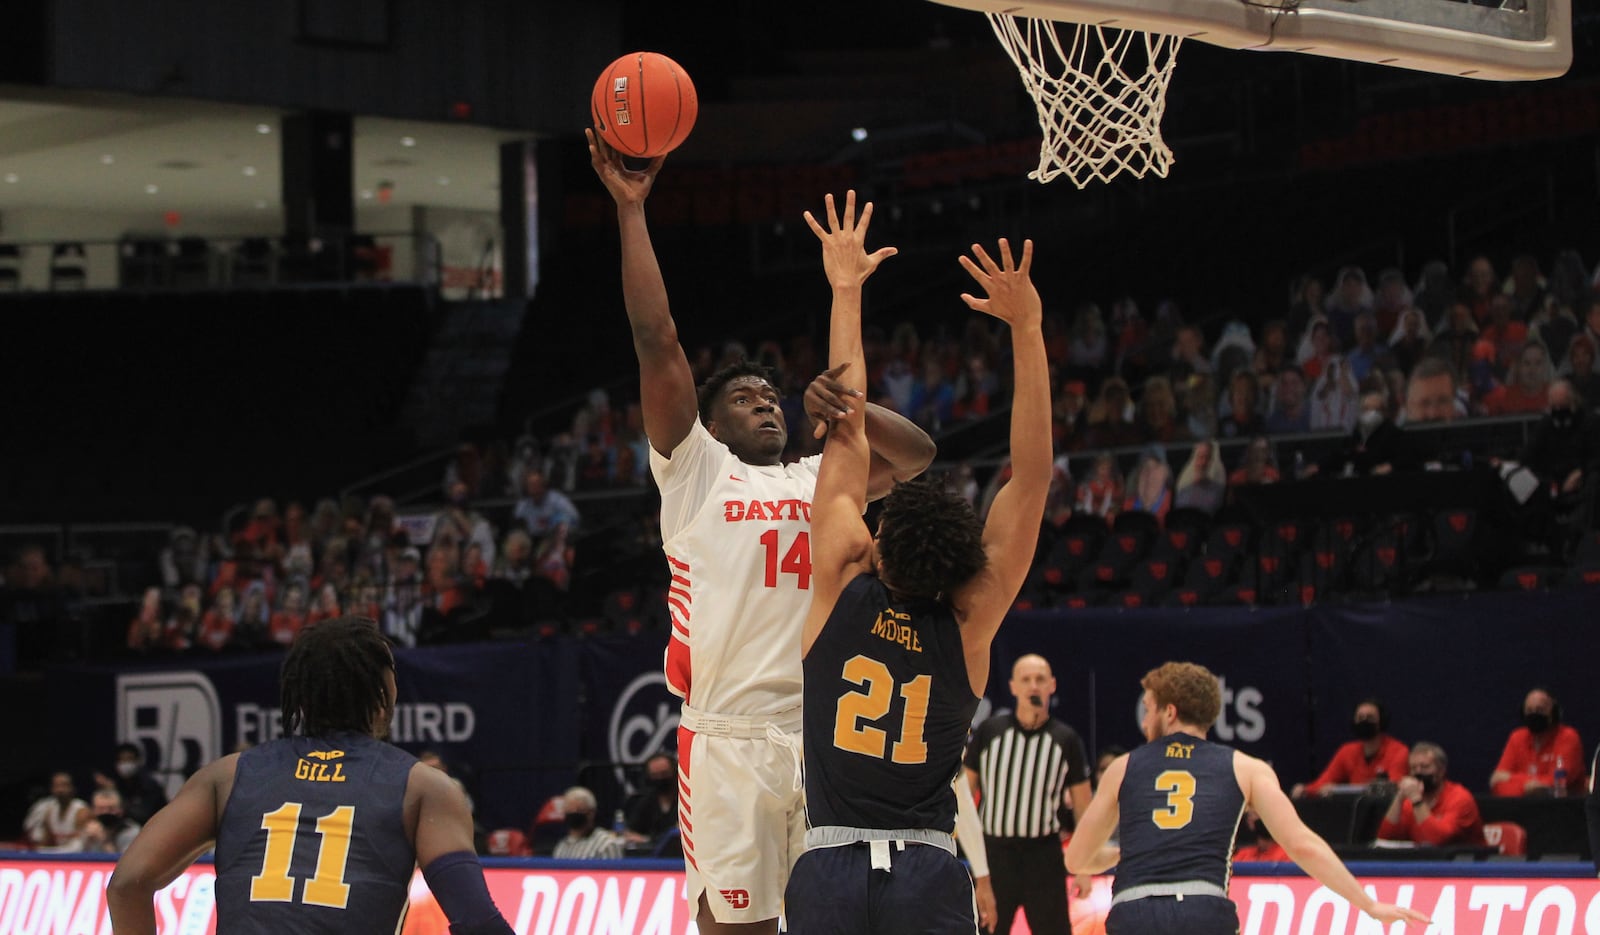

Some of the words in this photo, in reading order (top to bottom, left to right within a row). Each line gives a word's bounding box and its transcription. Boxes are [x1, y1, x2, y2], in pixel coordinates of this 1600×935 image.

[614, 76, 631, 126] ELITE
[760, 529, 812, 590] 14
[833, 654, 933, 764] 21
[295, 758, 346, 782] GILL
[1152, 770, 1197, 830] 3
[250, 802, 355, 909] 11
